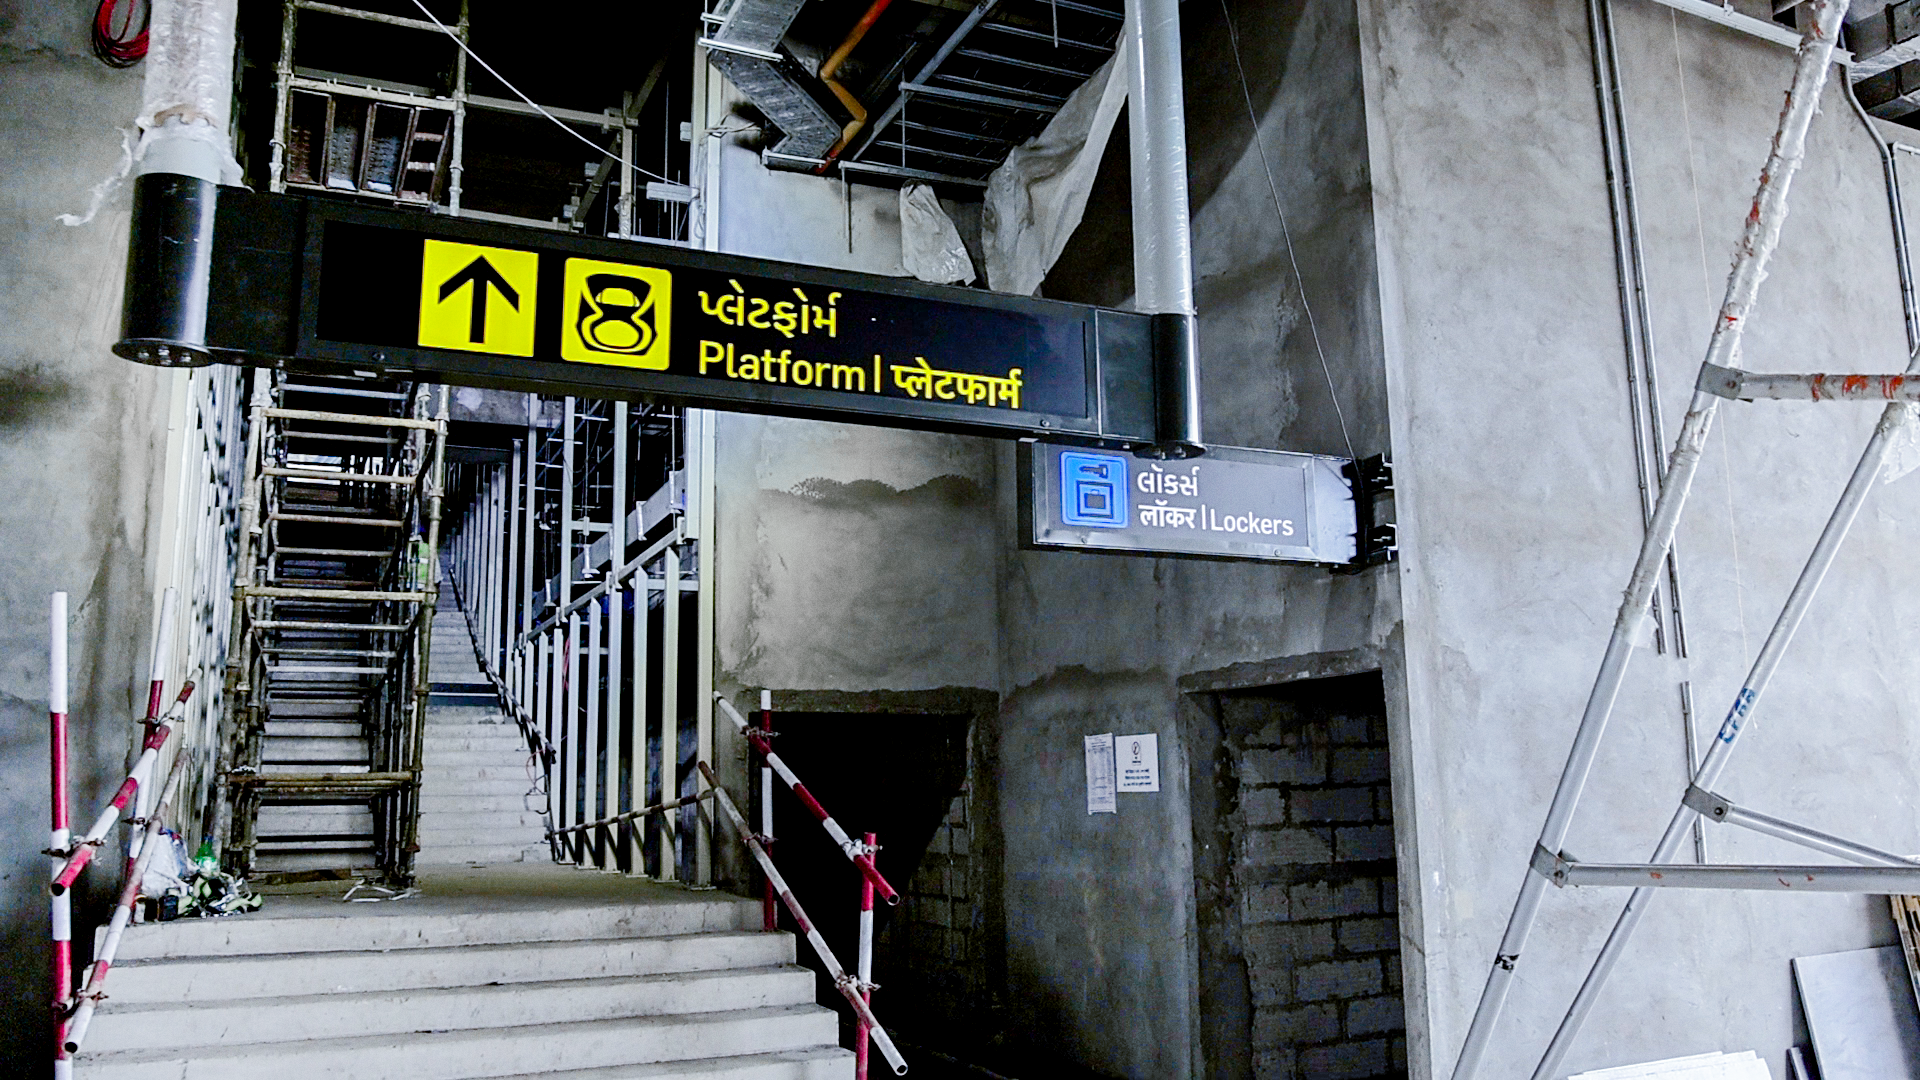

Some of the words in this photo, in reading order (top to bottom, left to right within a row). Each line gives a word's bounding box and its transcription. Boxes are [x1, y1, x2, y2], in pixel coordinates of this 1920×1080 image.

[698, 279, 842, 338] પ્લેટફોર્મ
[699, 340, 866, 392] Platform
[890, 357, 1022, 409] प्लेटफार्म
[1138, 499, 1197, 529] लॉकर
[1210, 508, 1294, 536] Lockers
